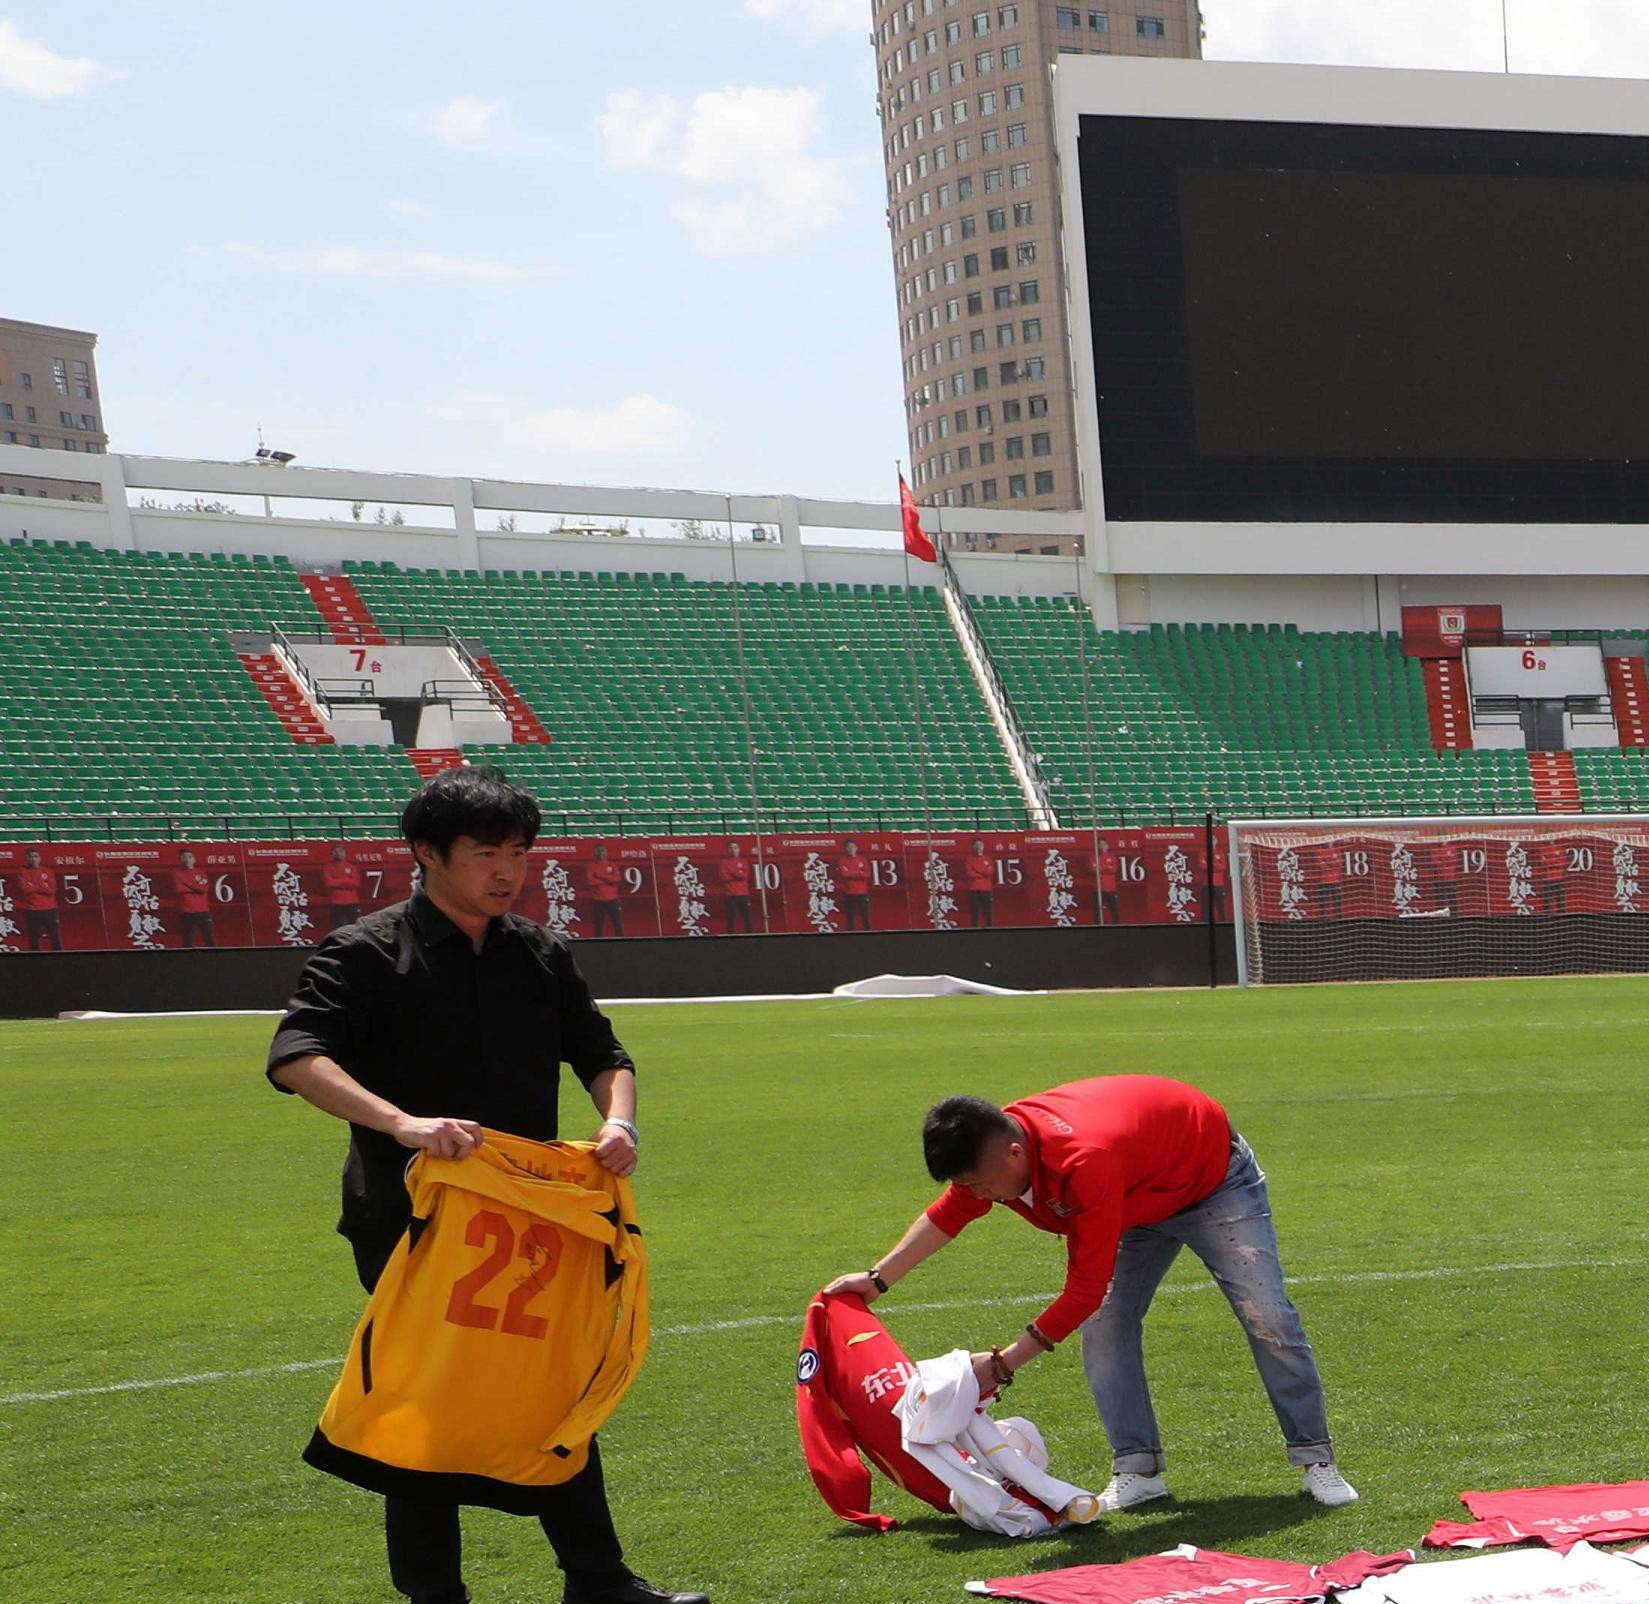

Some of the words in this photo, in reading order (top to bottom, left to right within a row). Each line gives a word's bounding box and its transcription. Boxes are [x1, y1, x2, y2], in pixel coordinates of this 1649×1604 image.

[350, 649, 382, 673] 7台
[1521, 650, 1547, 671] 6台
[871, 859, 899, 886] 13
[995, 858, 1023, 885] 15
[1118, 856, 1146, 881] 16
[1343, 851, 1370, 876] 18
[1461, 849, 1486, 873] 19
[1565, 847, 1593, 872] 20
[64, 875, 84, 905] 5
[215, 874, 235, 903] 6
[366, 870, 384, 898] 7
[624, 867, 643, 893] 9
[753, 863, 781, 891] 10
[444, 1208, 564, 1341] 22
